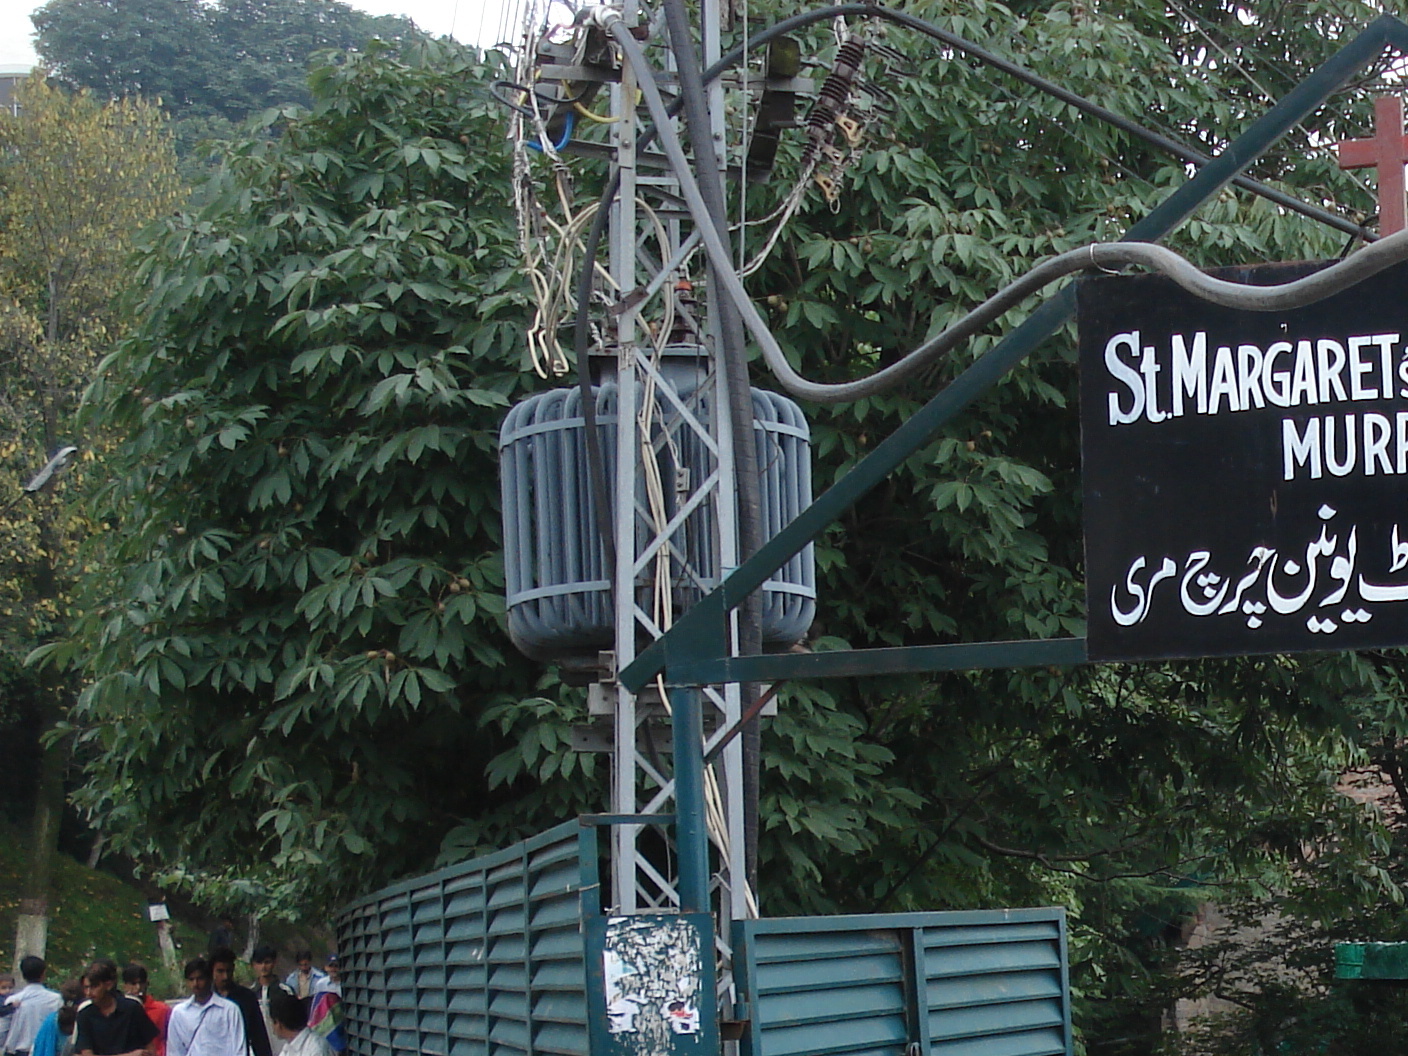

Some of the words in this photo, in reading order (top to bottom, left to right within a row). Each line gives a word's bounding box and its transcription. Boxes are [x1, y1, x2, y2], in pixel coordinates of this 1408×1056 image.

[1110, 553, 1177, 627] مری
[1179, 545, 1278, 630] چرچ
[1266, 503, 1373, 634] یونین
